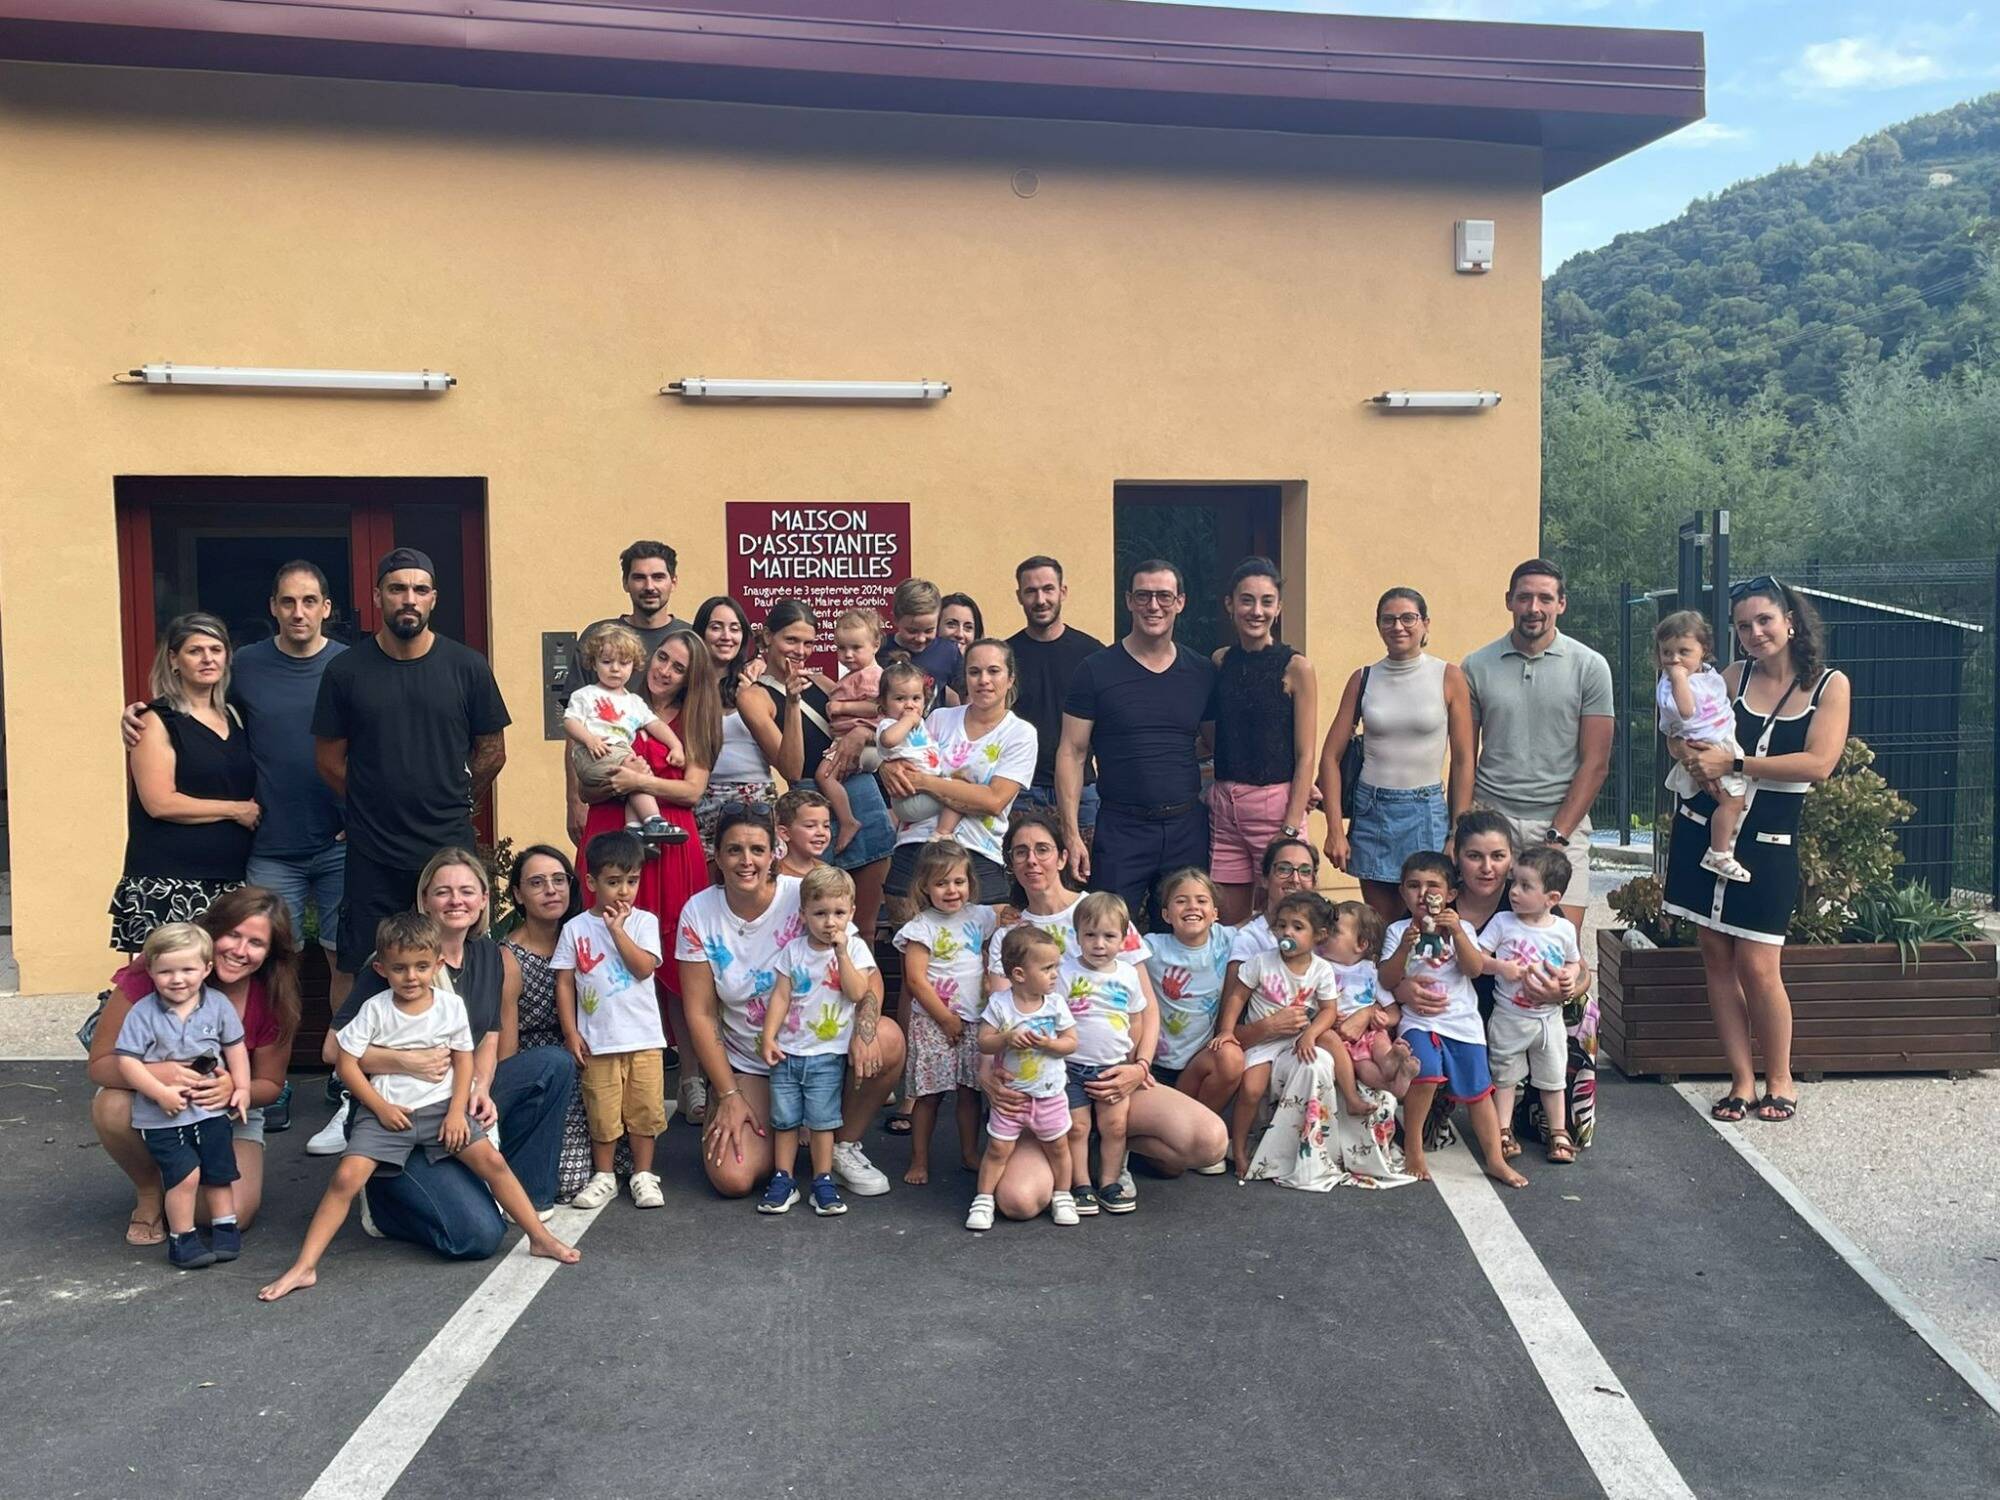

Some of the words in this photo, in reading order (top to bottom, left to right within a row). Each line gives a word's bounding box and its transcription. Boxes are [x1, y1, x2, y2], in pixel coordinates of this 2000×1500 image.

[772, 510, 867, 531] MAISON
[740, 534, 898, 555] D'ASSISTANTES
[750, 557, 892, 579] MATERNELLES
[743, 585, 792, 598] Inaugurée
[793, 585, 803, 595] le
[804, 585, 810, 595] 3
[810, 585, 860, 597] septembre
[861, 585, 882, 595] 2024
[883, 586, 897, 597] par
[754, 597, 773, 607] Paul
[815, 597, 841, 606] Maire
[842, 597, 855, 606] de
